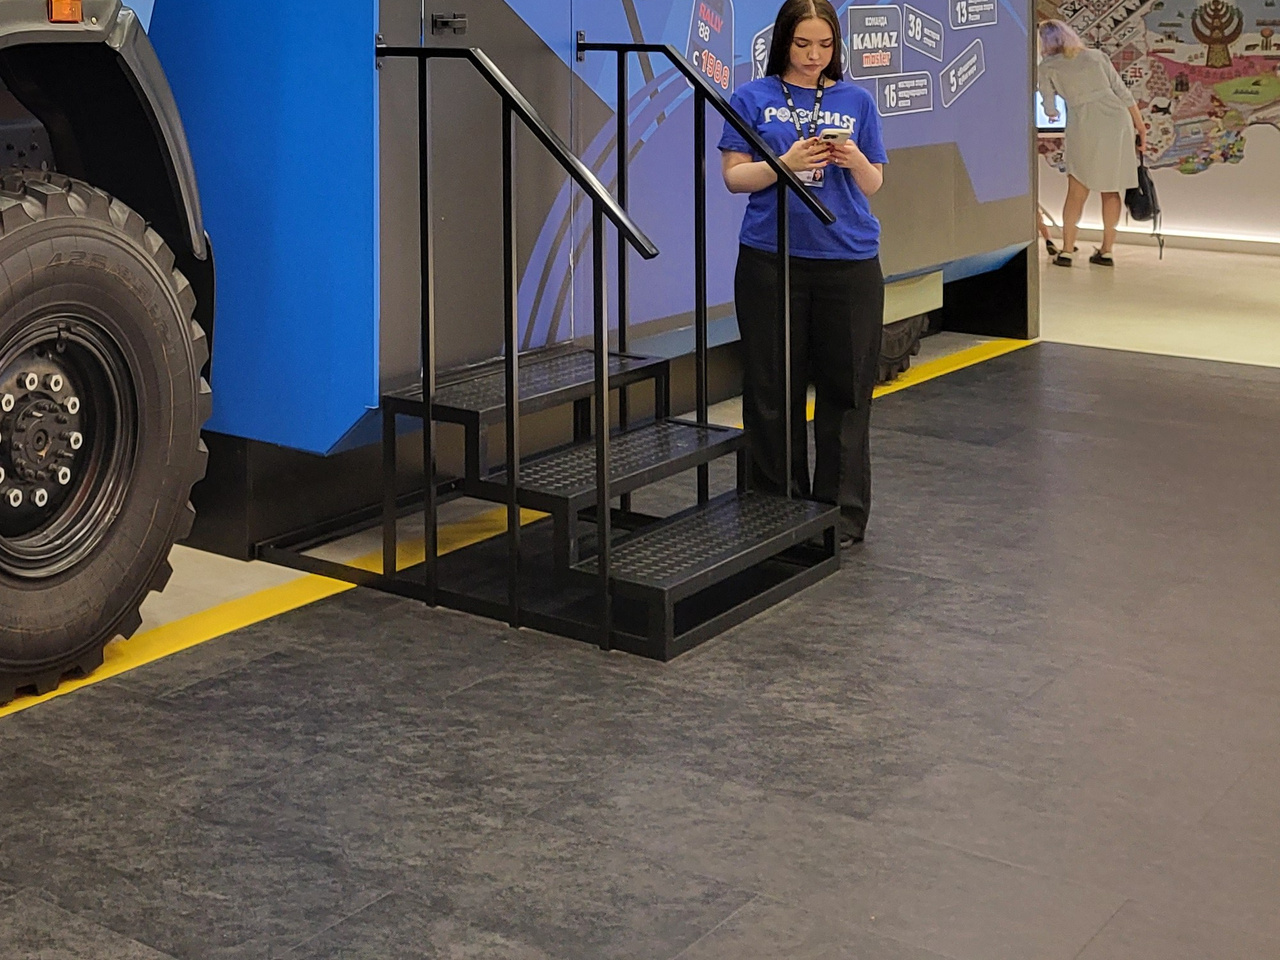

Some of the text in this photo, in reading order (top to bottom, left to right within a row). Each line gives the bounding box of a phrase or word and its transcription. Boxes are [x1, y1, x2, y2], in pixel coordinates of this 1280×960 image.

[698, 2, 724, 34] RALLY
[956, 1, 967, 24] 13
[908, 13, 922, 41] 38
[853, 31, 899, 50] KAMAZ
[701, 49, 730, 90] 1988
[862, 49, 891, 68] master
